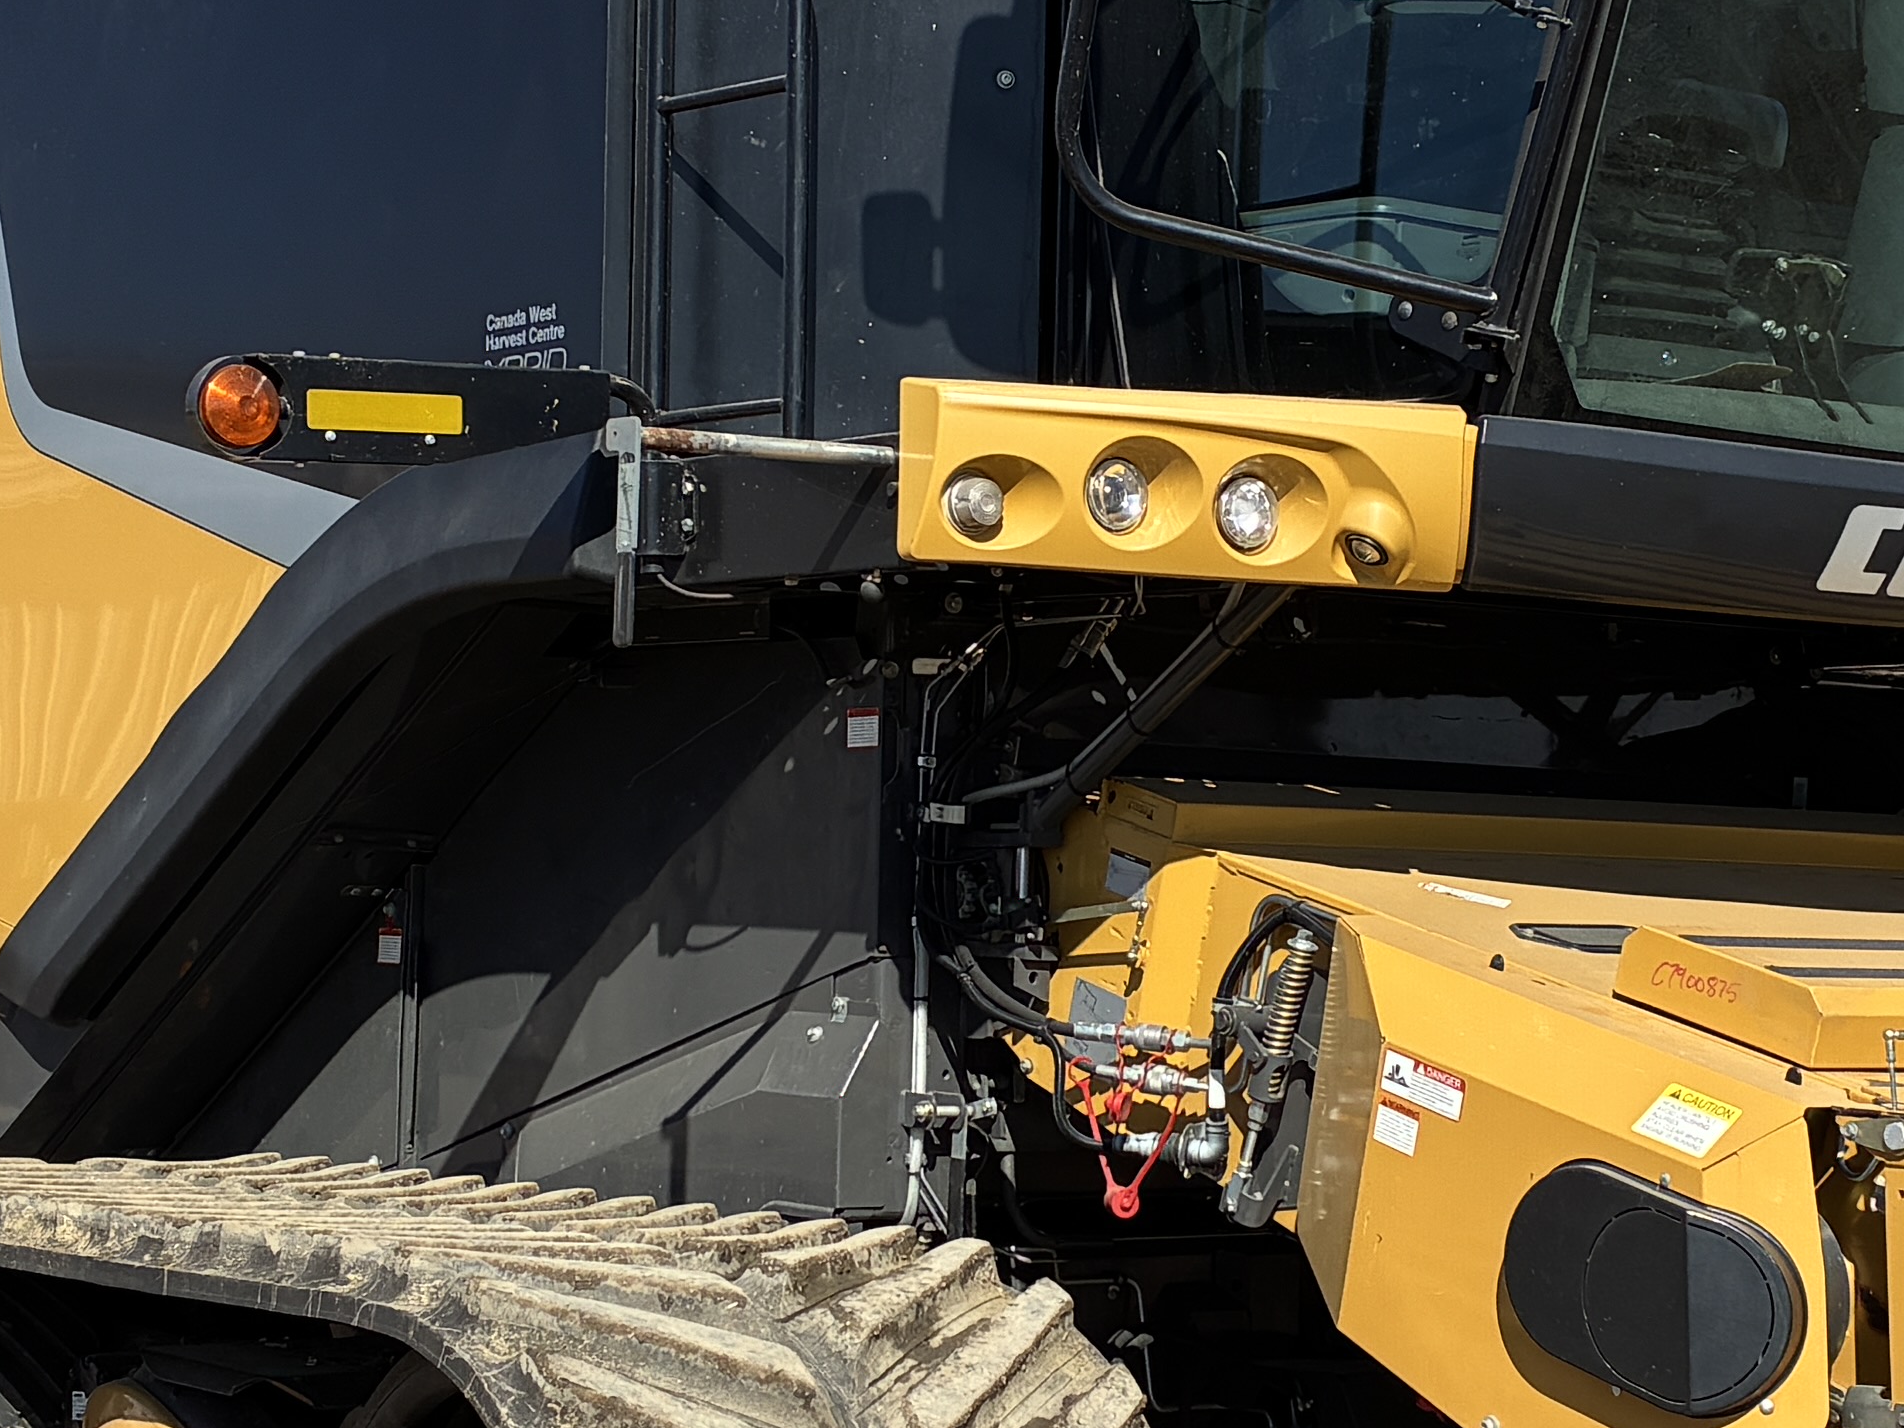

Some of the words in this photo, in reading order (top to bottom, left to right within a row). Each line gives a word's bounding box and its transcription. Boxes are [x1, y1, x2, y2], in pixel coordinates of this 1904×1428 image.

[486, 308, 527, 332] Canada
[528, 303, 557, 323] West
[485, 329, 527, 352] Harvest
[528, 324, 565, 344] Centre
[1426, 1066, 1462, 1091] DANGER
[1682, 1093, 1736, 1120] CAUTION
